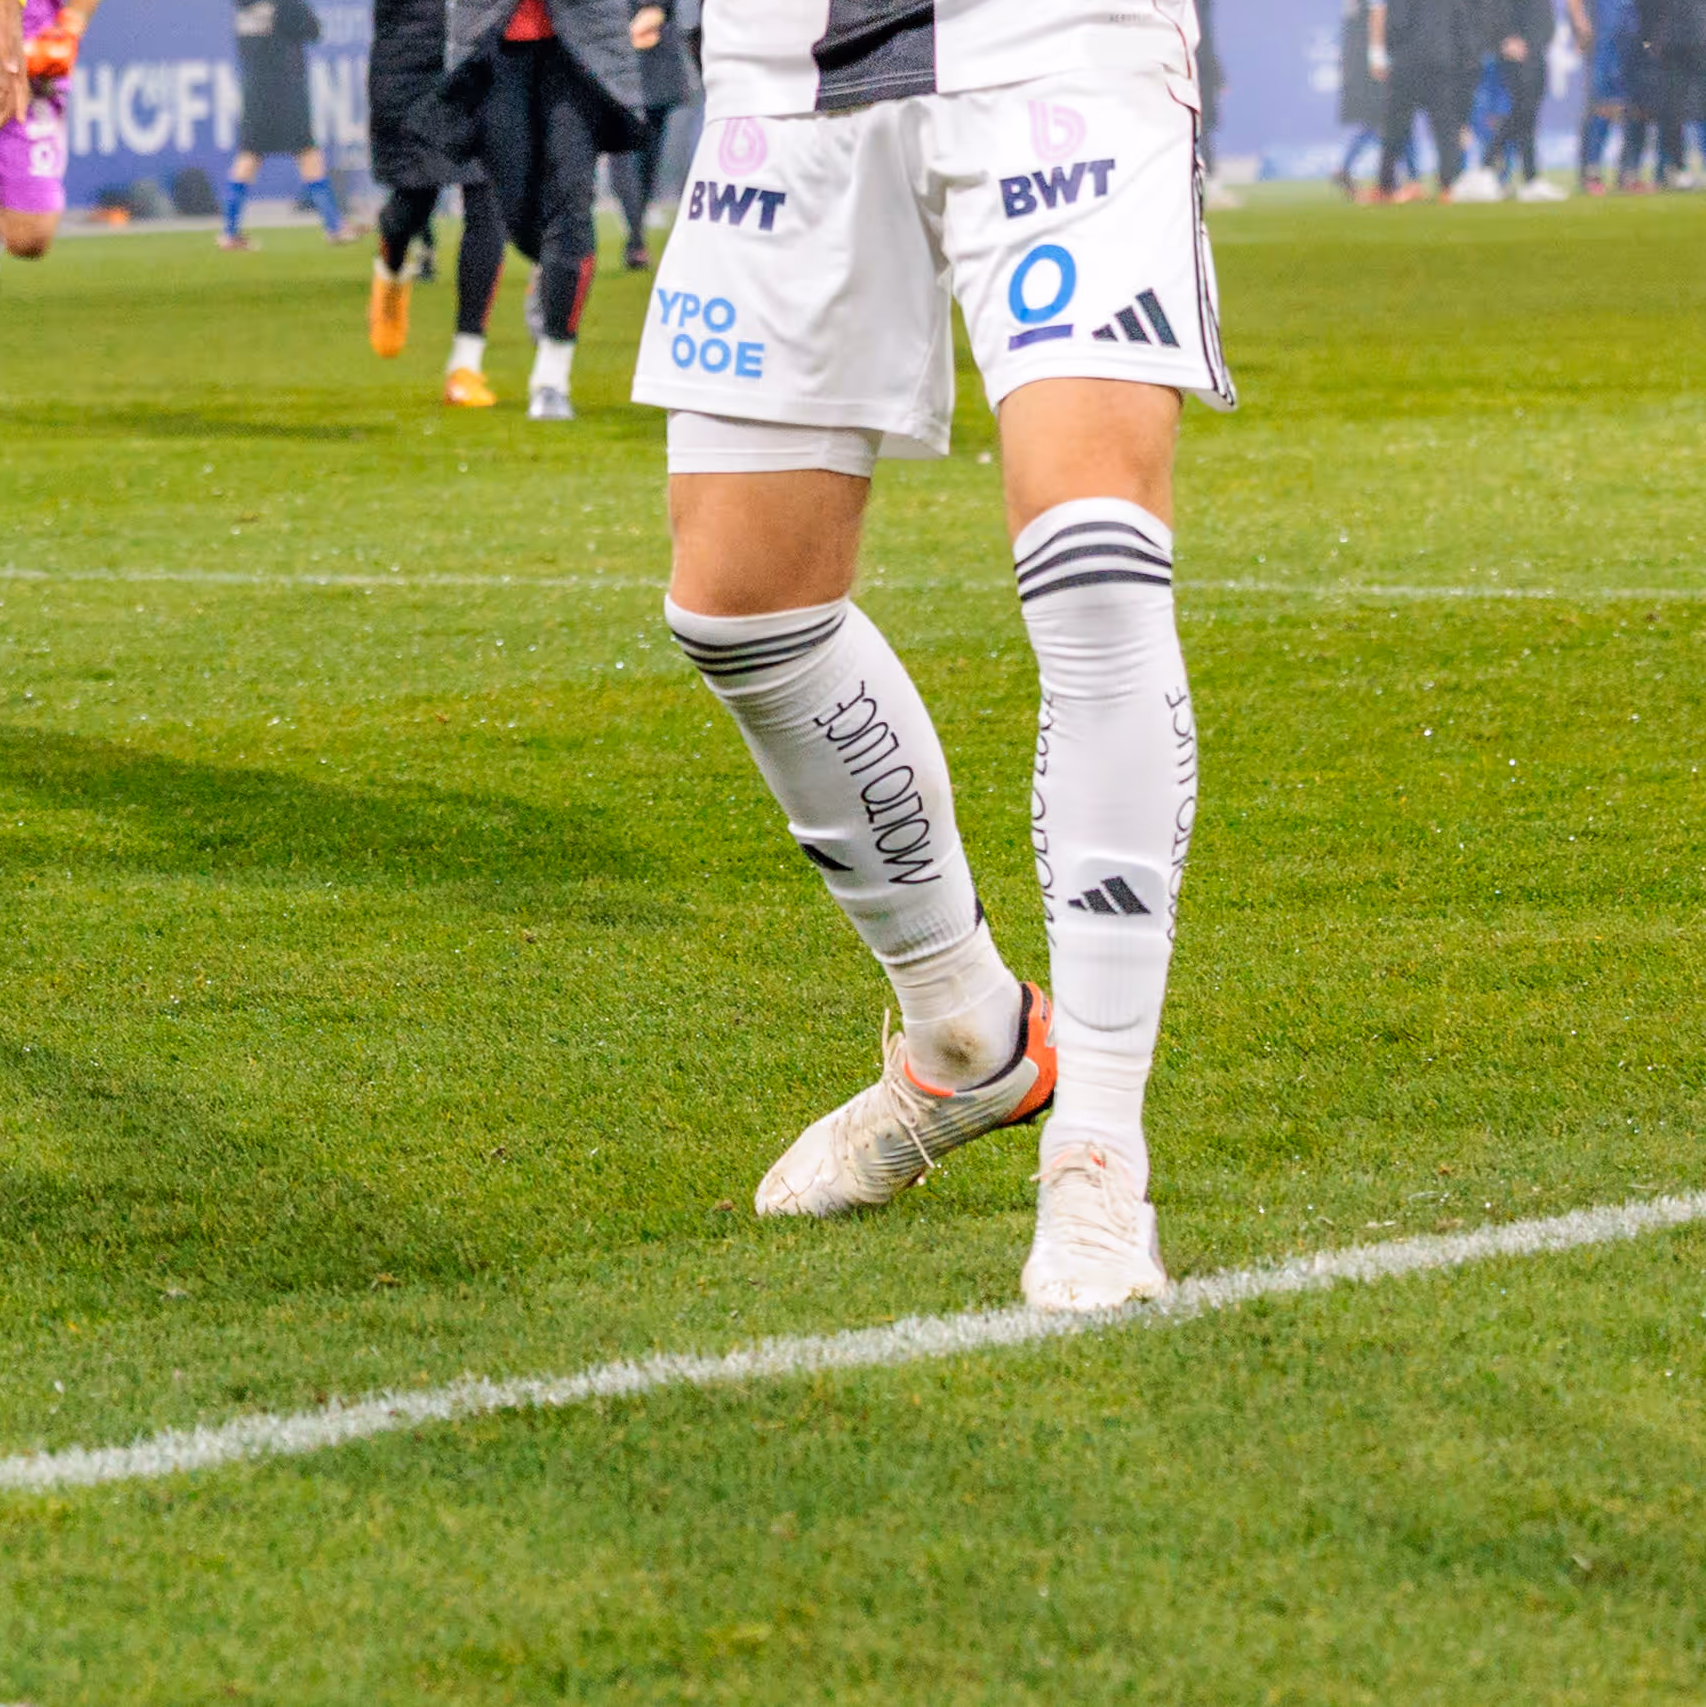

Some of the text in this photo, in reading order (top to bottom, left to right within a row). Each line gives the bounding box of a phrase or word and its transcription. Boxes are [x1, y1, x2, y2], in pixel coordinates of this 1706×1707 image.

[688, 181, 786, 231] BWT
[1000, 159, 1115, 219] BWT
[657, 288, 736, 333] YPO
[671, 334, 765, 378] OOE
[813, 681, 942, 886] MOLTO LUCE
